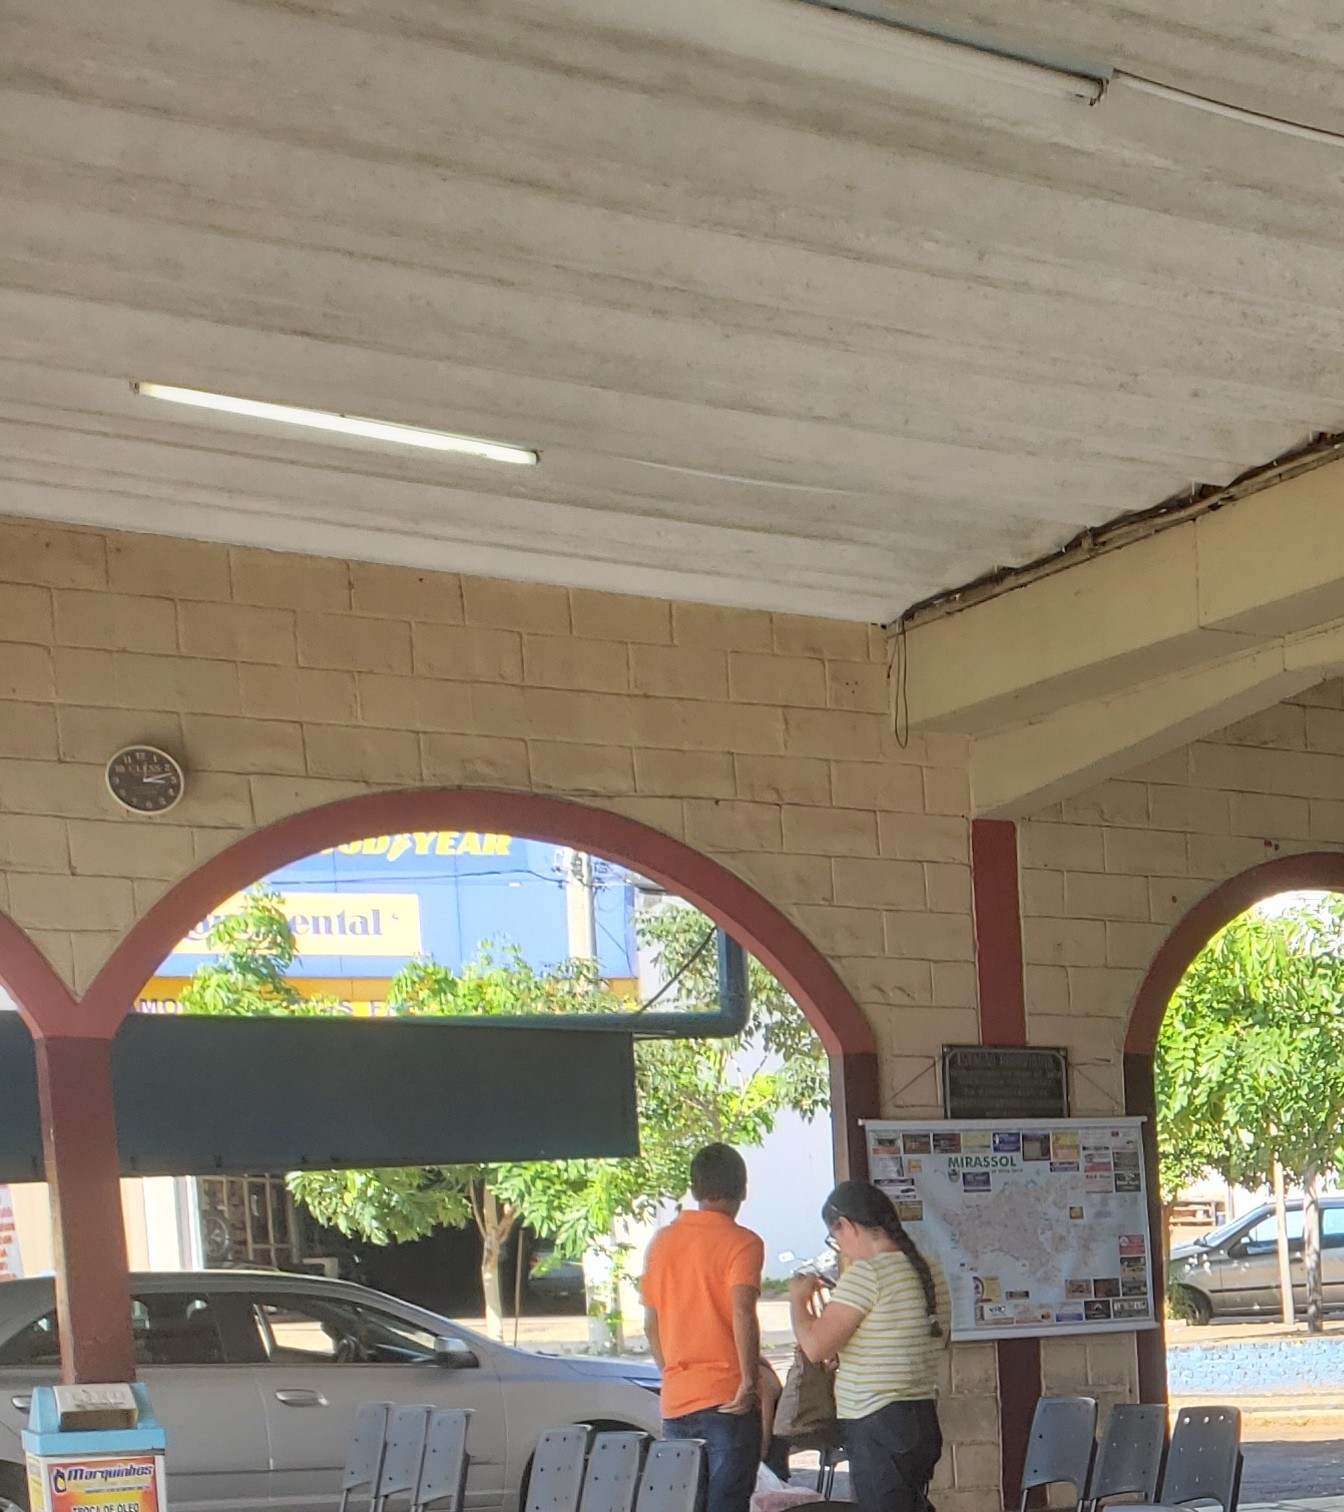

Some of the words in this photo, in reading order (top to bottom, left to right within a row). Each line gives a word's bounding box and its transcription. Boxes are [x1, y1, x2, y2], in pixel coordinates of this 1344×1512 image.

[320, 831, 512, 860] ODYEAR
[948, 1156, 1017, 1168] MIRASSOL
[67, 1464, 153, 1482] Marquinhos
